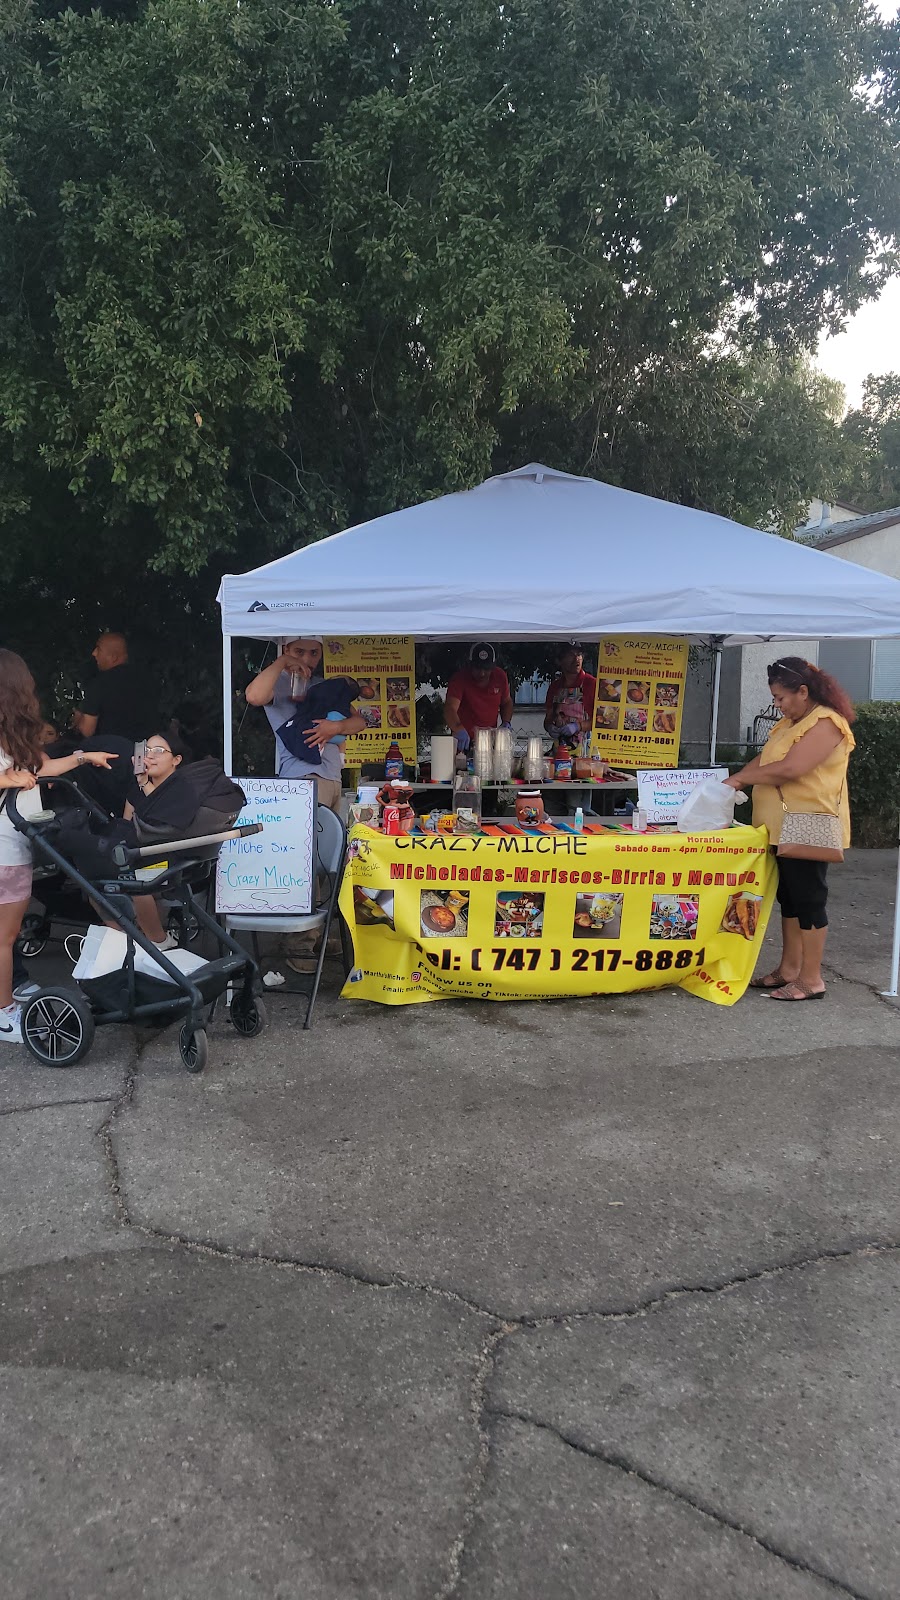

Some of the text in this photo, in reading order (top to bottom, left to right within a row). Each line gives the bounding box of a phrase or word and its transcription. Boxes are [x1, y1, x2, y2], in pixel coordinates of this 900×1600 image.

[347, 636, 410, 646] CRAZY-MICHE
[623, 640, 685, 653] CRAZY-MICHE
[597, 732, 612, 740] Tel:
[618, 734, 632, 742] 747
[638, 736, 674, 745] 217-8881
[236, 813, 282, 828] aby Miche
[228, 838, 288, 855] Miche Six
[394, 837, 588, 856] CRAZY-MICHE
[687, 836, 724, 844] Horario:
[615, 844, 649, 853] Sabado
[679, 845, 698, 855] 4pm
[706, 846, 744, 855] Domingo
[227, 863, 260, 888] Crazy
[390, 863, 667, 886] Micheladas-Mariscos-Birria
[672, 874, 682, 887] y
[688, 870, 760, 886] Menudo.
[491, 948, 542, 971] 747
[571, 946, 706, 972] 217-8881
[417, 961, 454, 985] Follow
[715, 980, 733, 996] CA.
